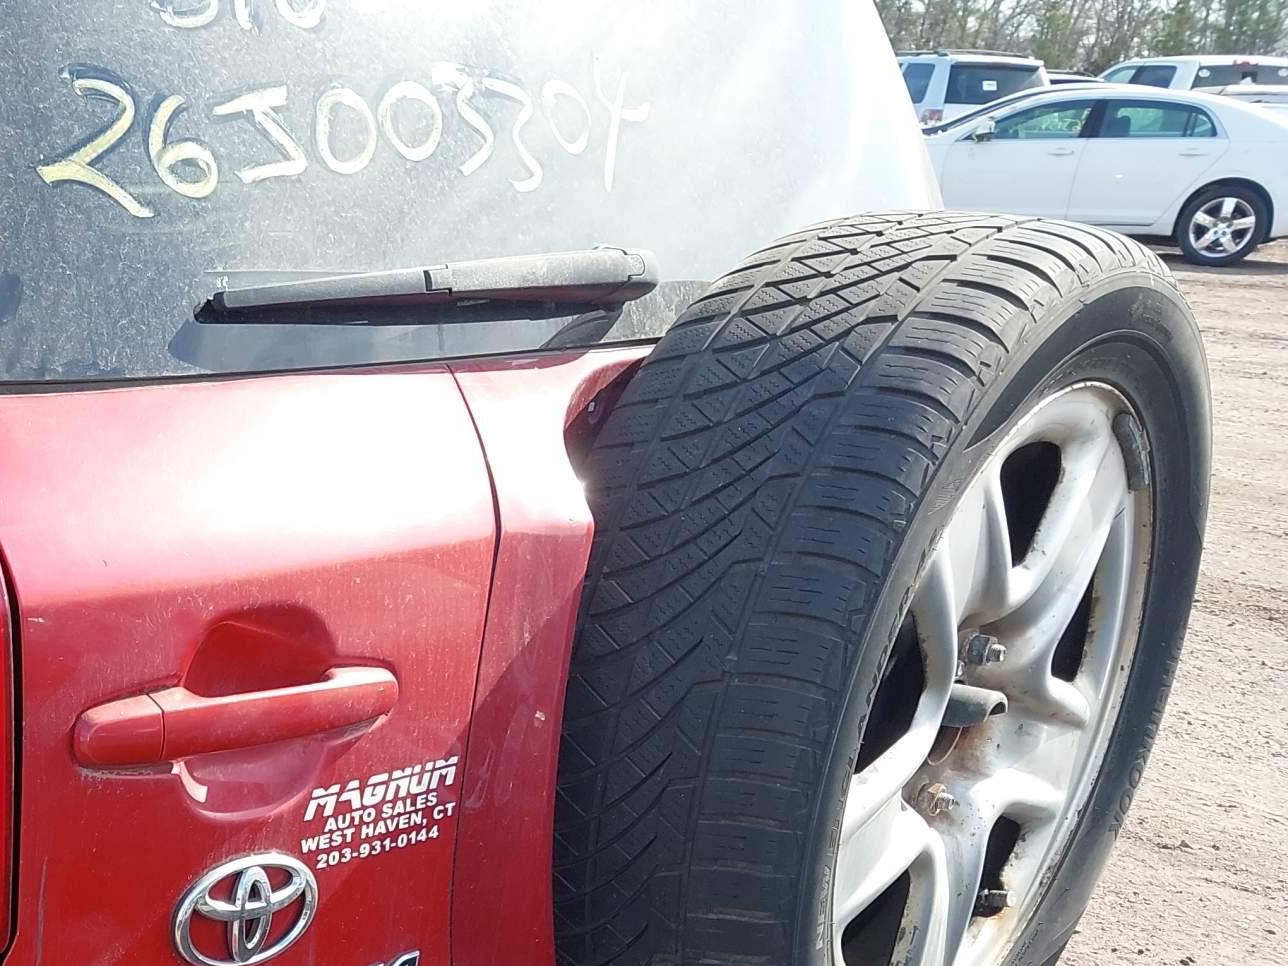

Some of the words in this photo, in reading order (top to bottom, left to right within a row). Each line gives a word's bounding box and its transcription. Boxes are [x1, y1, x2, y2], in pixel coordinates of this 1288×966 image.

[304, 756, 459, 821] MAGNUM
[301, 827, 356, 853] WEST
[361, 812, 427, 839] HAVEN,
[433, 802, 456, 820] CT
[324, 807, 376, 833] AUTO
[381, 792, 438, 818] SALES
[316, 825, 439, 869] 203-931-0144
